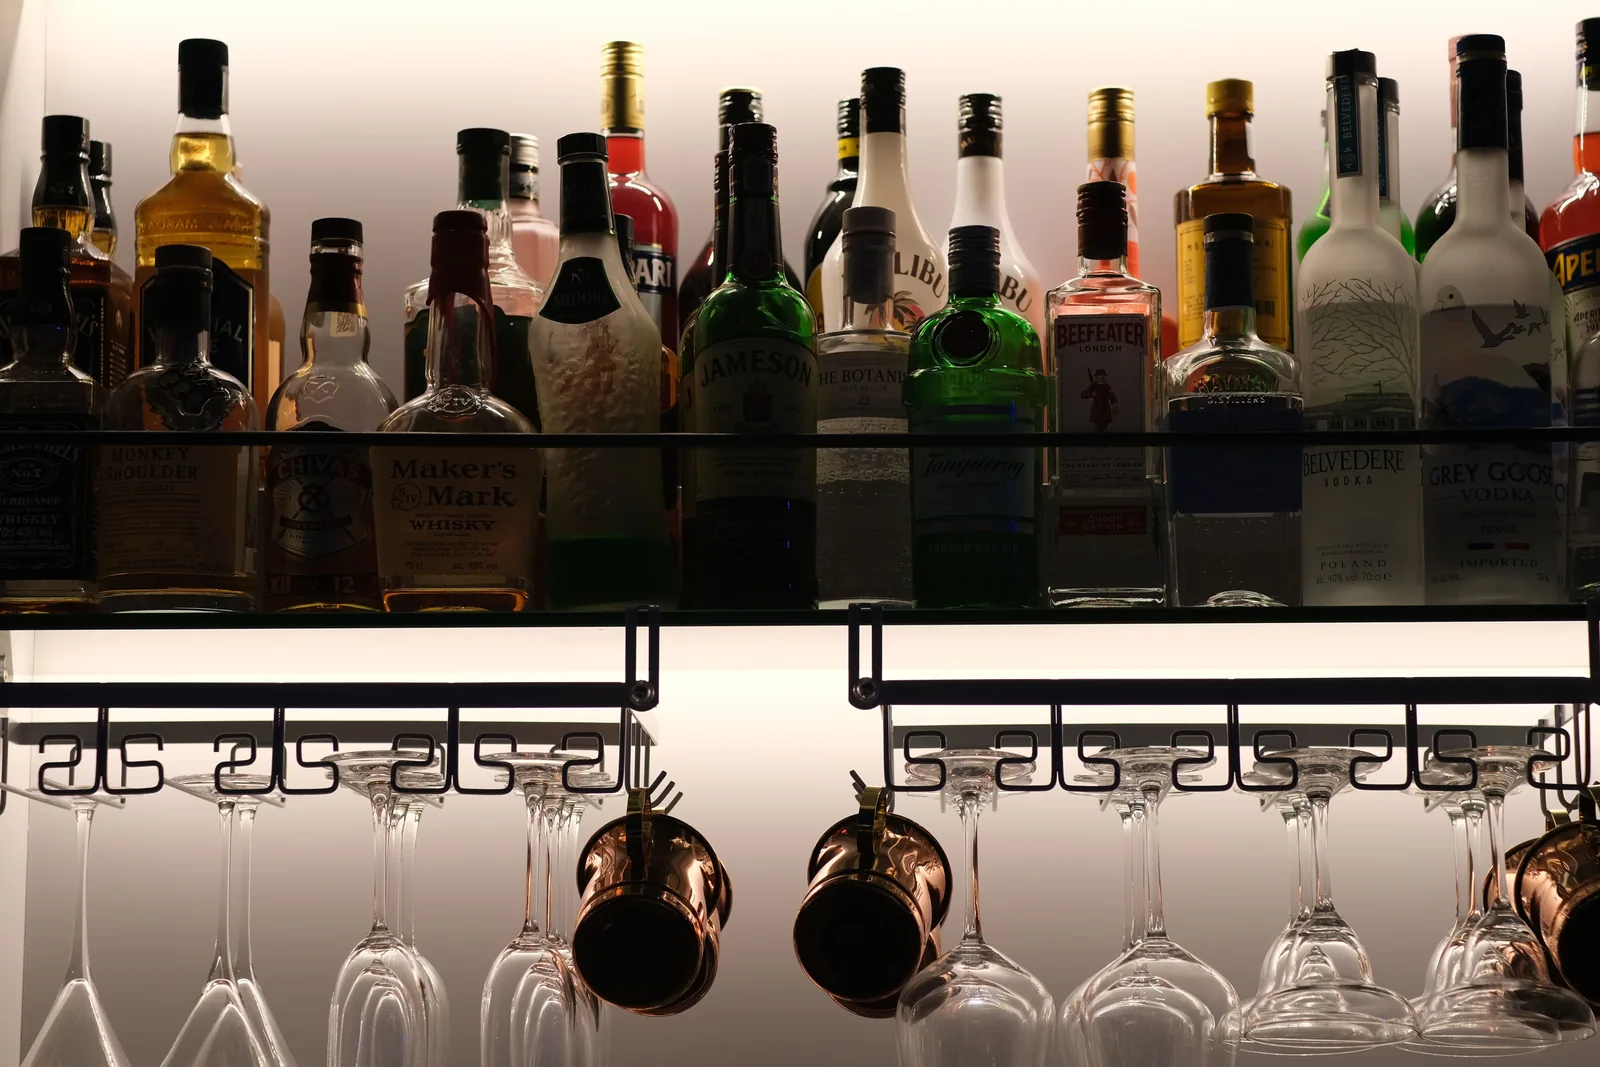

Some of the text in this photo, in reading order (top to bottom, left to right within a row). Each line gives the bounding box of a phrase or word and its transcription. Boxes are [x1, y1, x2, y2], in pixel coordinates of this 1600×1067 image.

[634, 257, 673, 288] ARI
[894, 251, 945, 298] LIBU
[1056, 322, 1145, 350] BEEFEATER
[701, 350, 812, 388] JAMESON
[815, 368, 908, 386] HE BOTANIS
[857, 395, 870, 405] 22
[111, 447, 189, 463] MONKEY
[1303, 449, 1405, 476] BELVEDERE
[107, 464, 198, 482] SHOULDER
[278, 455, 362, 479] CHIVAS
[389, 458, 517, 479] Maker's
[924, 453, 1026, 478] Tanqueray
[1429, 463, 1480, 486] GREY
[1324, 475, 1373, 488] VODKA
[425, 485, 517, 507] Mark
[1460, 487, 1534, 502] VODKA
[409, 520, 497, 531] WHISKY
[1083, 515, 1123, 523] LONDON
[1083, 523, 1123, 531] DRY GIN
[1320, 559, 1387, 570] POLAND
[1460, 558, 1538, 567] IMPORTED
[268, 576, 292, 595] XII
[332, 575, 357, 594] 12
[1327, 573, 1344, 583] 40%
[1345, 573, 1358, 582] vol
[1362, 572, 1373, 582] 70
